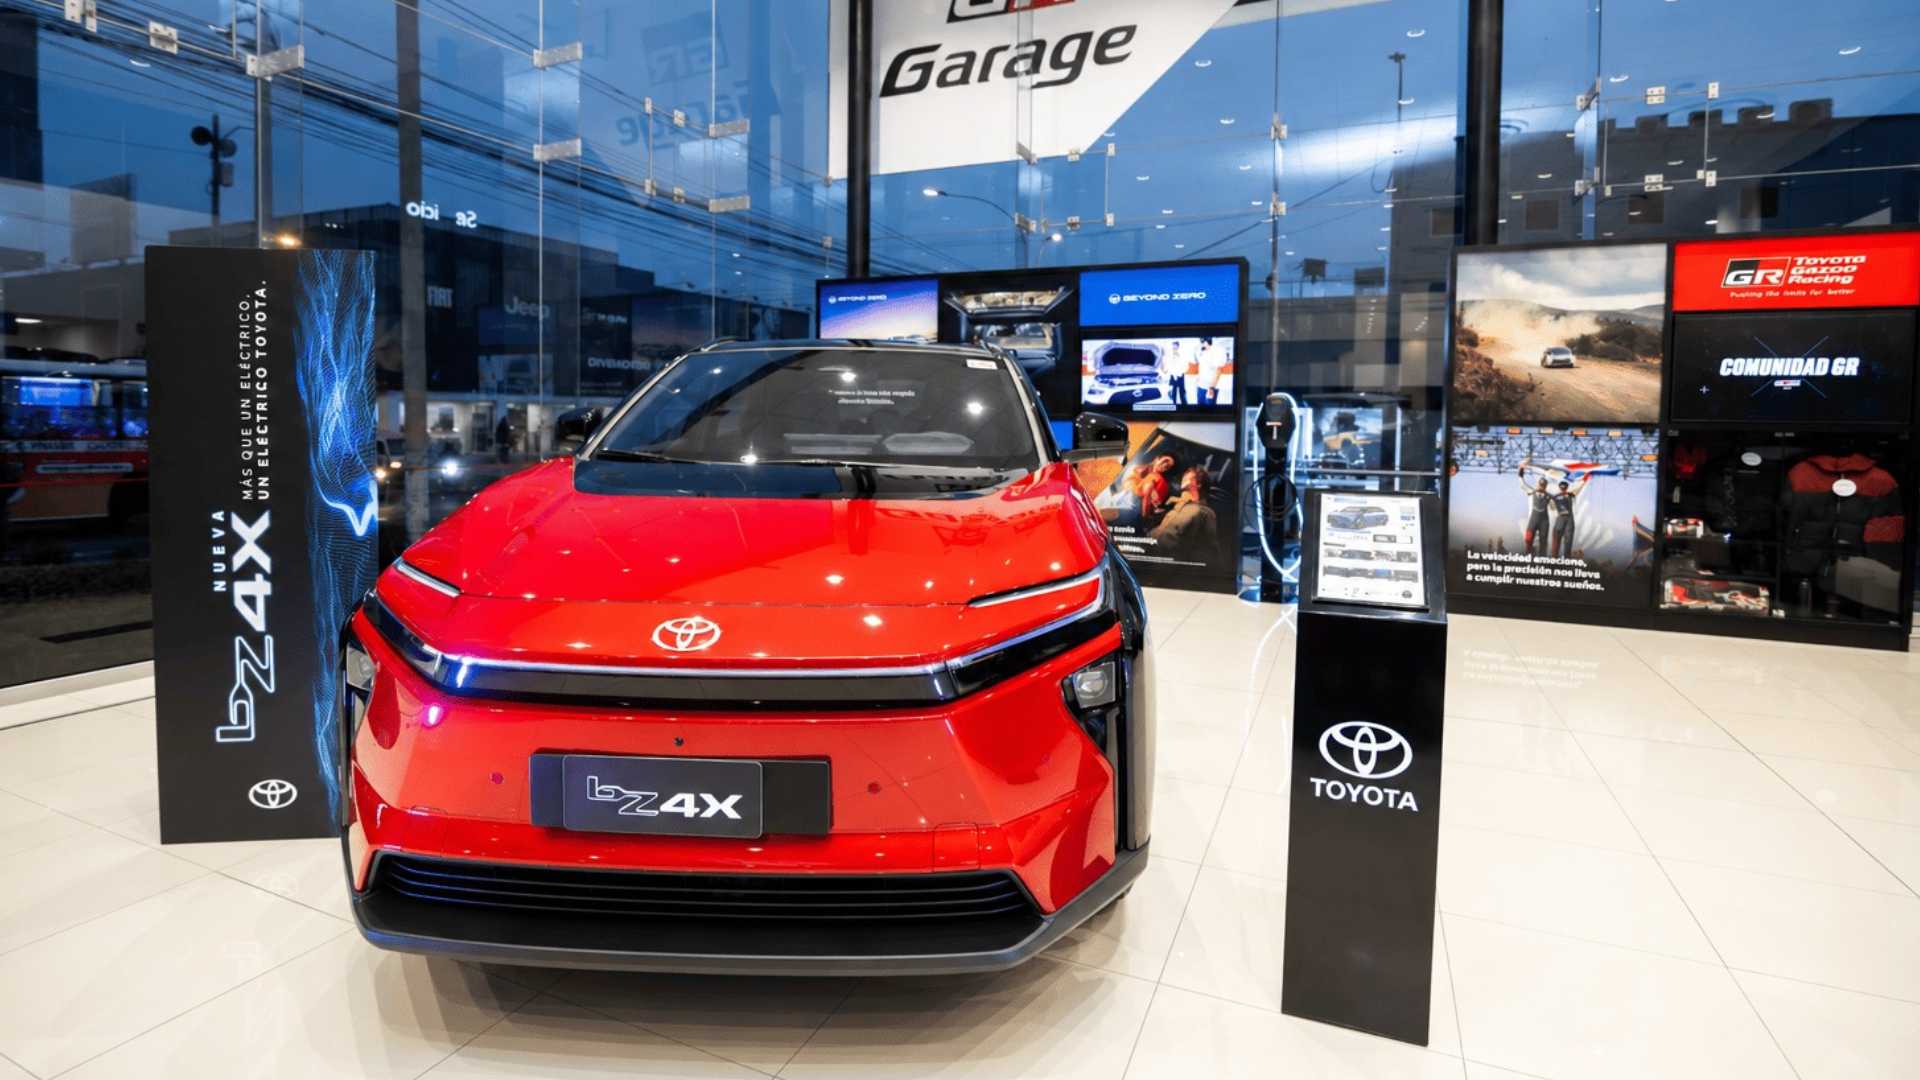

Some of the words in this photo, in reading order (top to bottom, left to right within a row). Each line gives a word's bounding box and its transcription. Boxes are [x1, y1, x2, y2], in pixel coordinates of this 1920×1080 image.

[879, 24, 1138, 98] Garage
[1793, 255, 1867, 266] Toyota
[1725, 269, 1784, 286] GR
[1790, 265, 1857, 275] Gazoo
[1788, 275, 1854, 285] Racing
[1123, 293, 1170, 302] BEYOND
[254, 280, 268, 359] TOYOTA.
[238, 294, 252, 390] ELÉCTRICO,
[1719, 357, 1830, 376] COMUNIDAD
[1831, 357, 1860, 376] GR
[240, 398, 252, 421] UN
[240, 428, 254, 461] QUE
[240, 468, 254, 500] MÁS
[257, 476, 270, 500] UN
[211, 510, 226, 592] NUEVA
[1467, 550, 1480, 559] La
[1481, 551, 1532, 563] velocidad
[1466, 562, 1491, 573] pero
[1553, 568, 1573, 578] nos
[1574, 568, 1601, 579] lleva
[1474, 573, 1513, 586] cumplir
[1515, 577, 1562, 588] nuestros
[1310, 777, 1419, 812] TOYOTA
